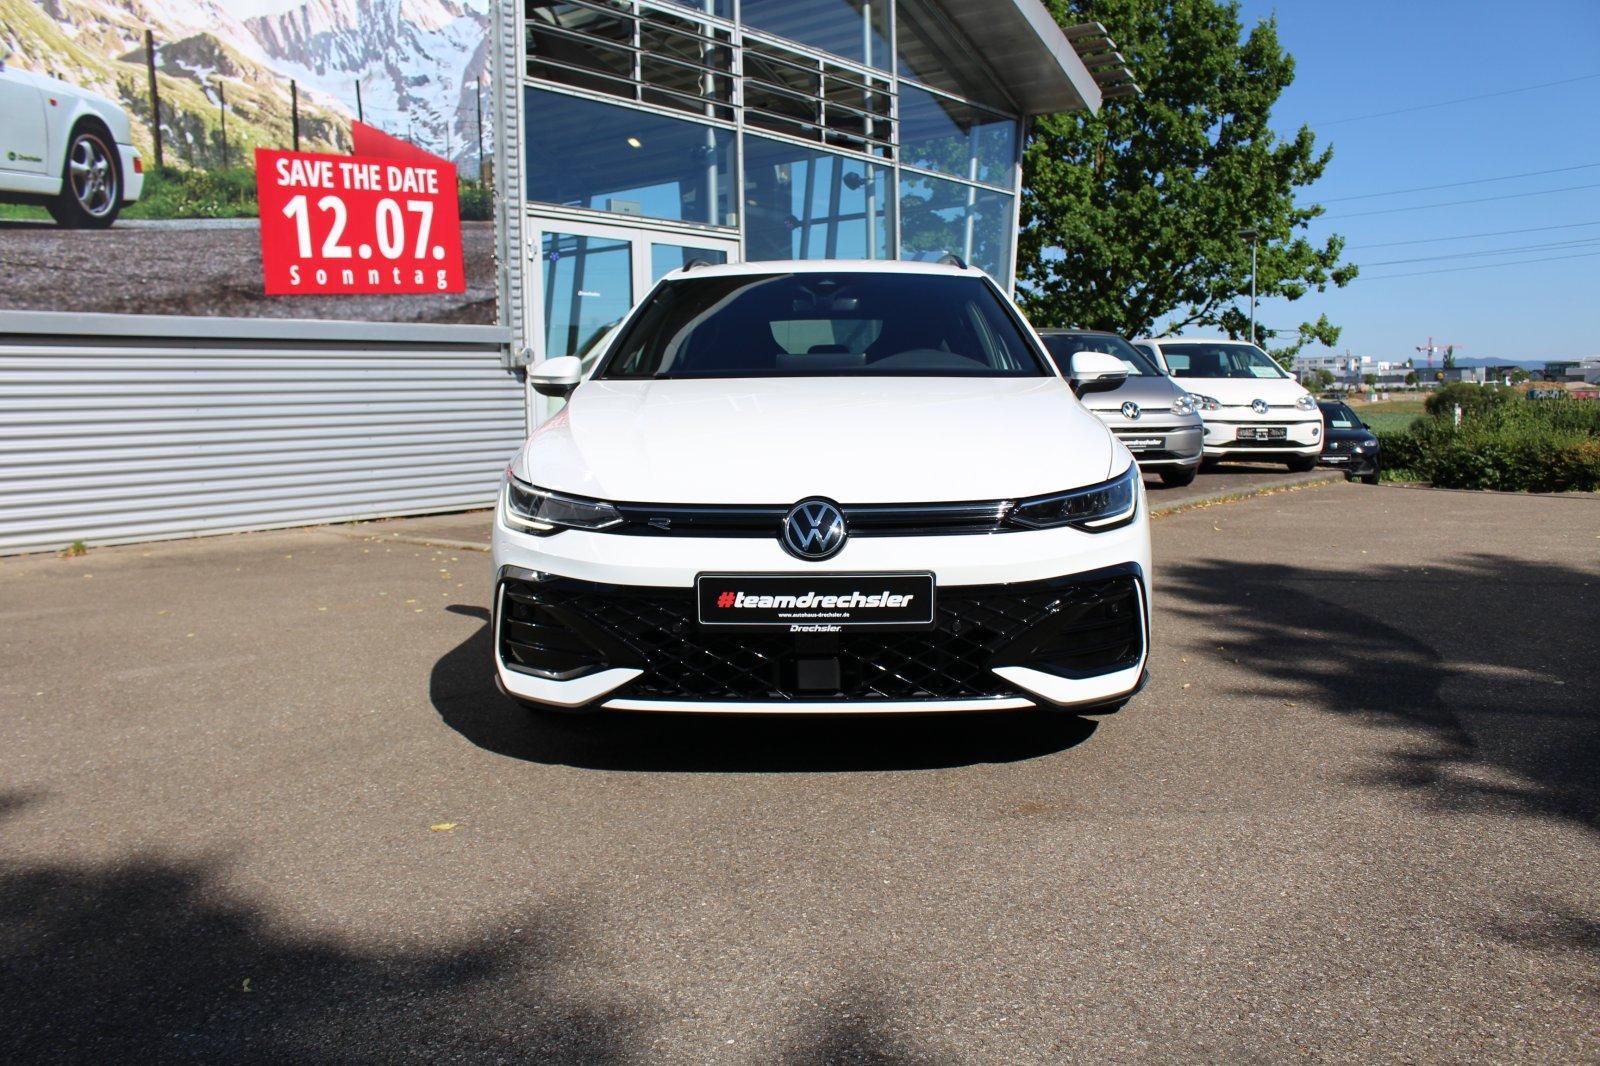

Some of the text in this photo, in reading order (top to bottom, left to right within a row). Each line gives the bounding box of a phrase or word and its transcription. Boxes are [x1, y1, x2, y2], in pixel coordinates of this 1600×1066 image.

[276, 157, 439, 194] SAVE THE DATE
[282, 194, 446, 260] 12.07.
[289, 264, 448, 290] Sonntag
[786, 502, 844, 556] VW
[717, 591, 914, 609] #teamdrechsler
